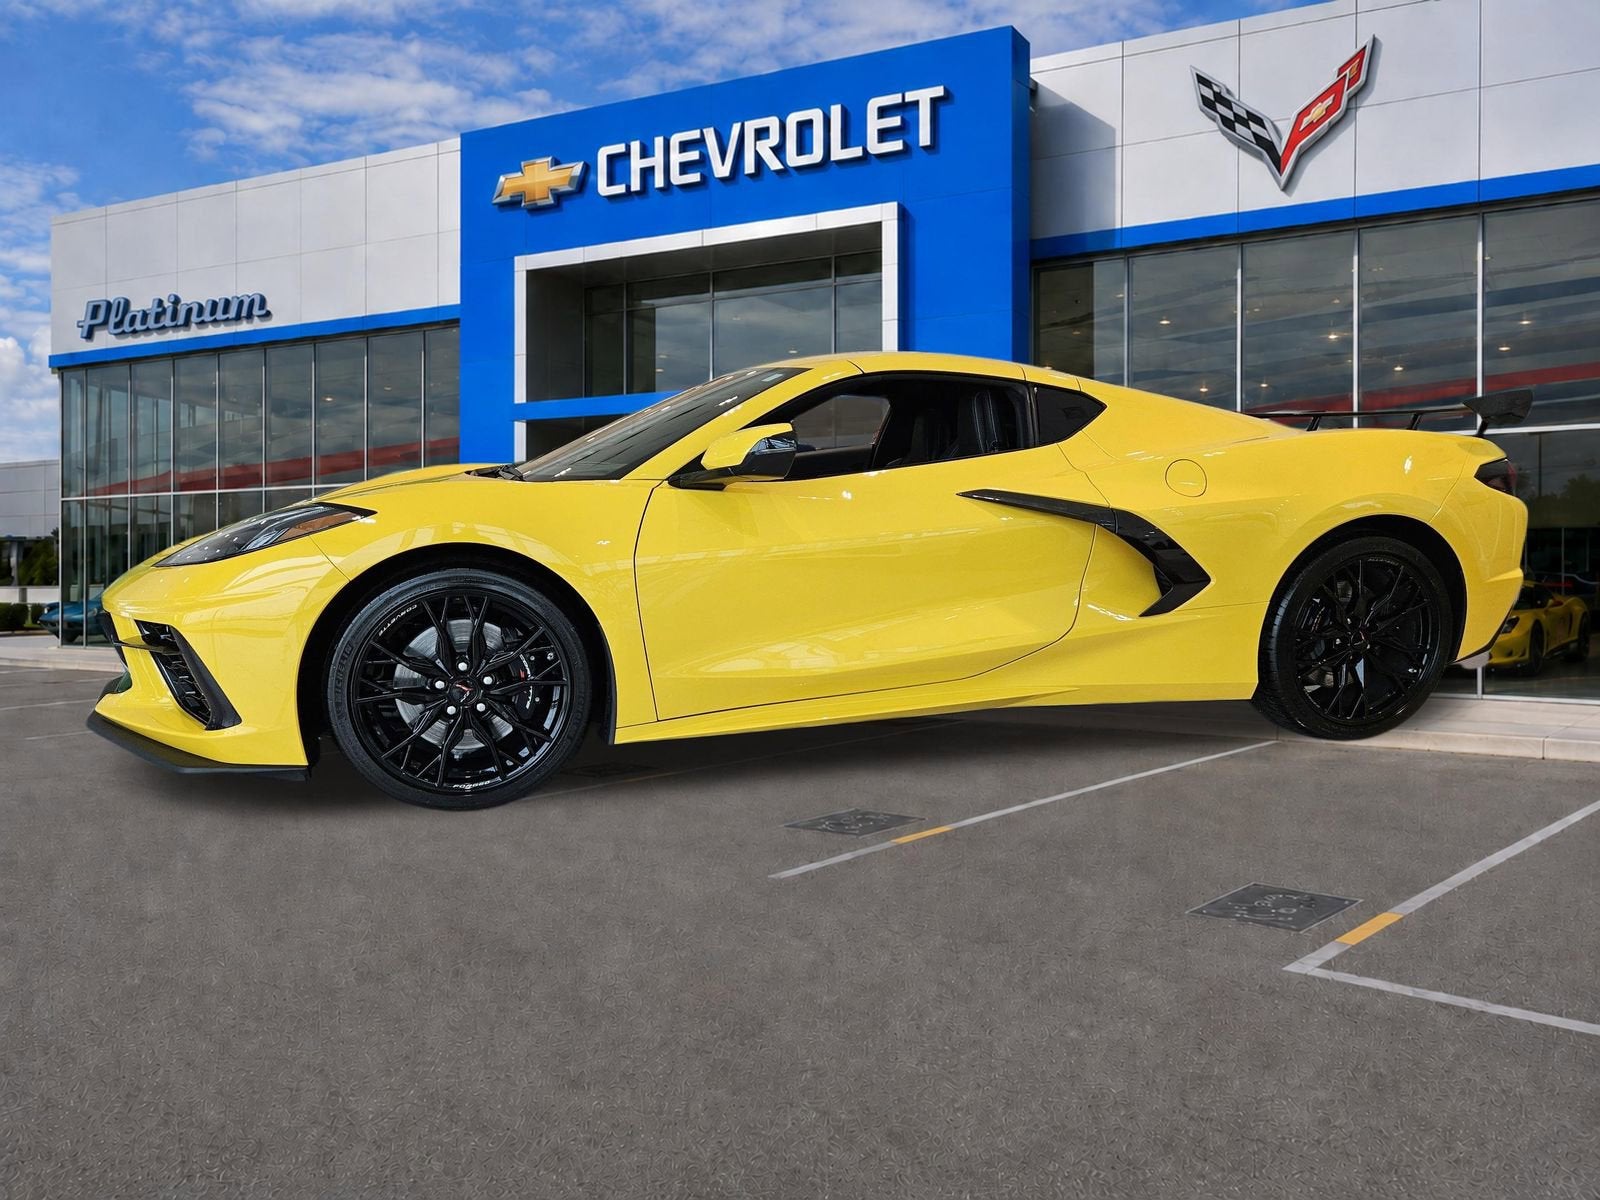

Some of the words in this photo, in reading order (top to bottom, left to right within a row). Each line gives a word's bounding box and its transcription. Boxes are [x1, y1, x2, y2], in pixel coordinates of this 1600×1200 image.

[596, 85, 946, 198] CHEVROLET
[77, 293, 271, 340] Platinum
[334, 641, 354, 704] MICHELIN
